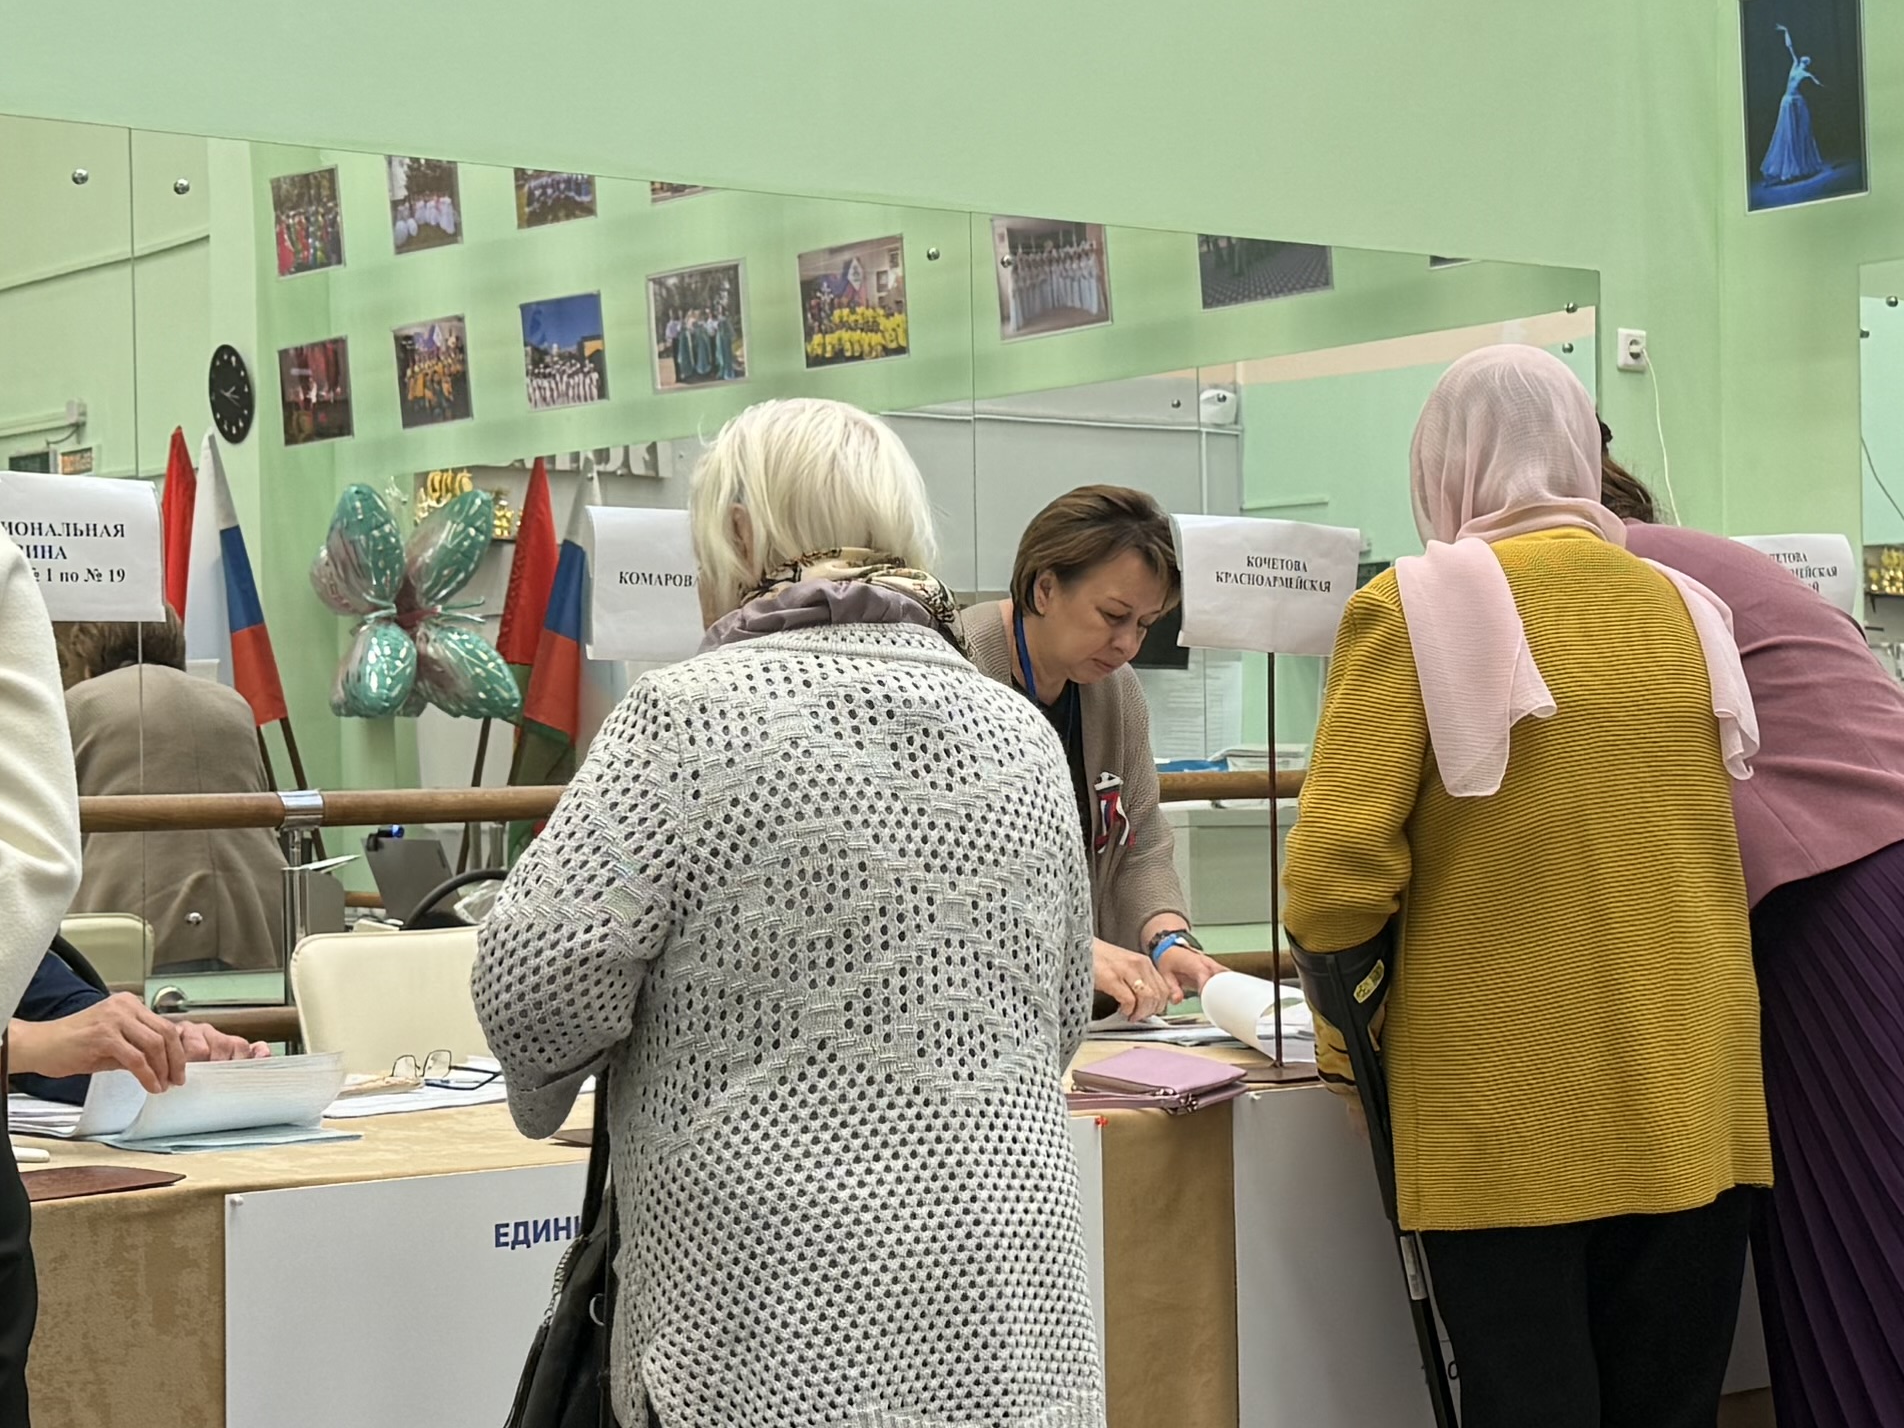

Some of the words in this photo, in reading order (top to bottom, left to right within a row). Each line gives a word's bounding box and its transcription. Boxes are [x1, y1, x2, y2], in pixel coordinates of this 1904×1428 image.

[0, 521, 126, 538] ИОНАЛЬНАЯ
[1246, 554, 1308, 573] КОЧЕТОВА
[60, 571, 80, 583] по
[84, 568, 103, 582] №
[108, 568, 126, 583] 19
[1215, 571, 1332, 593] КРАСНОАРМЕЙСКАЯ
